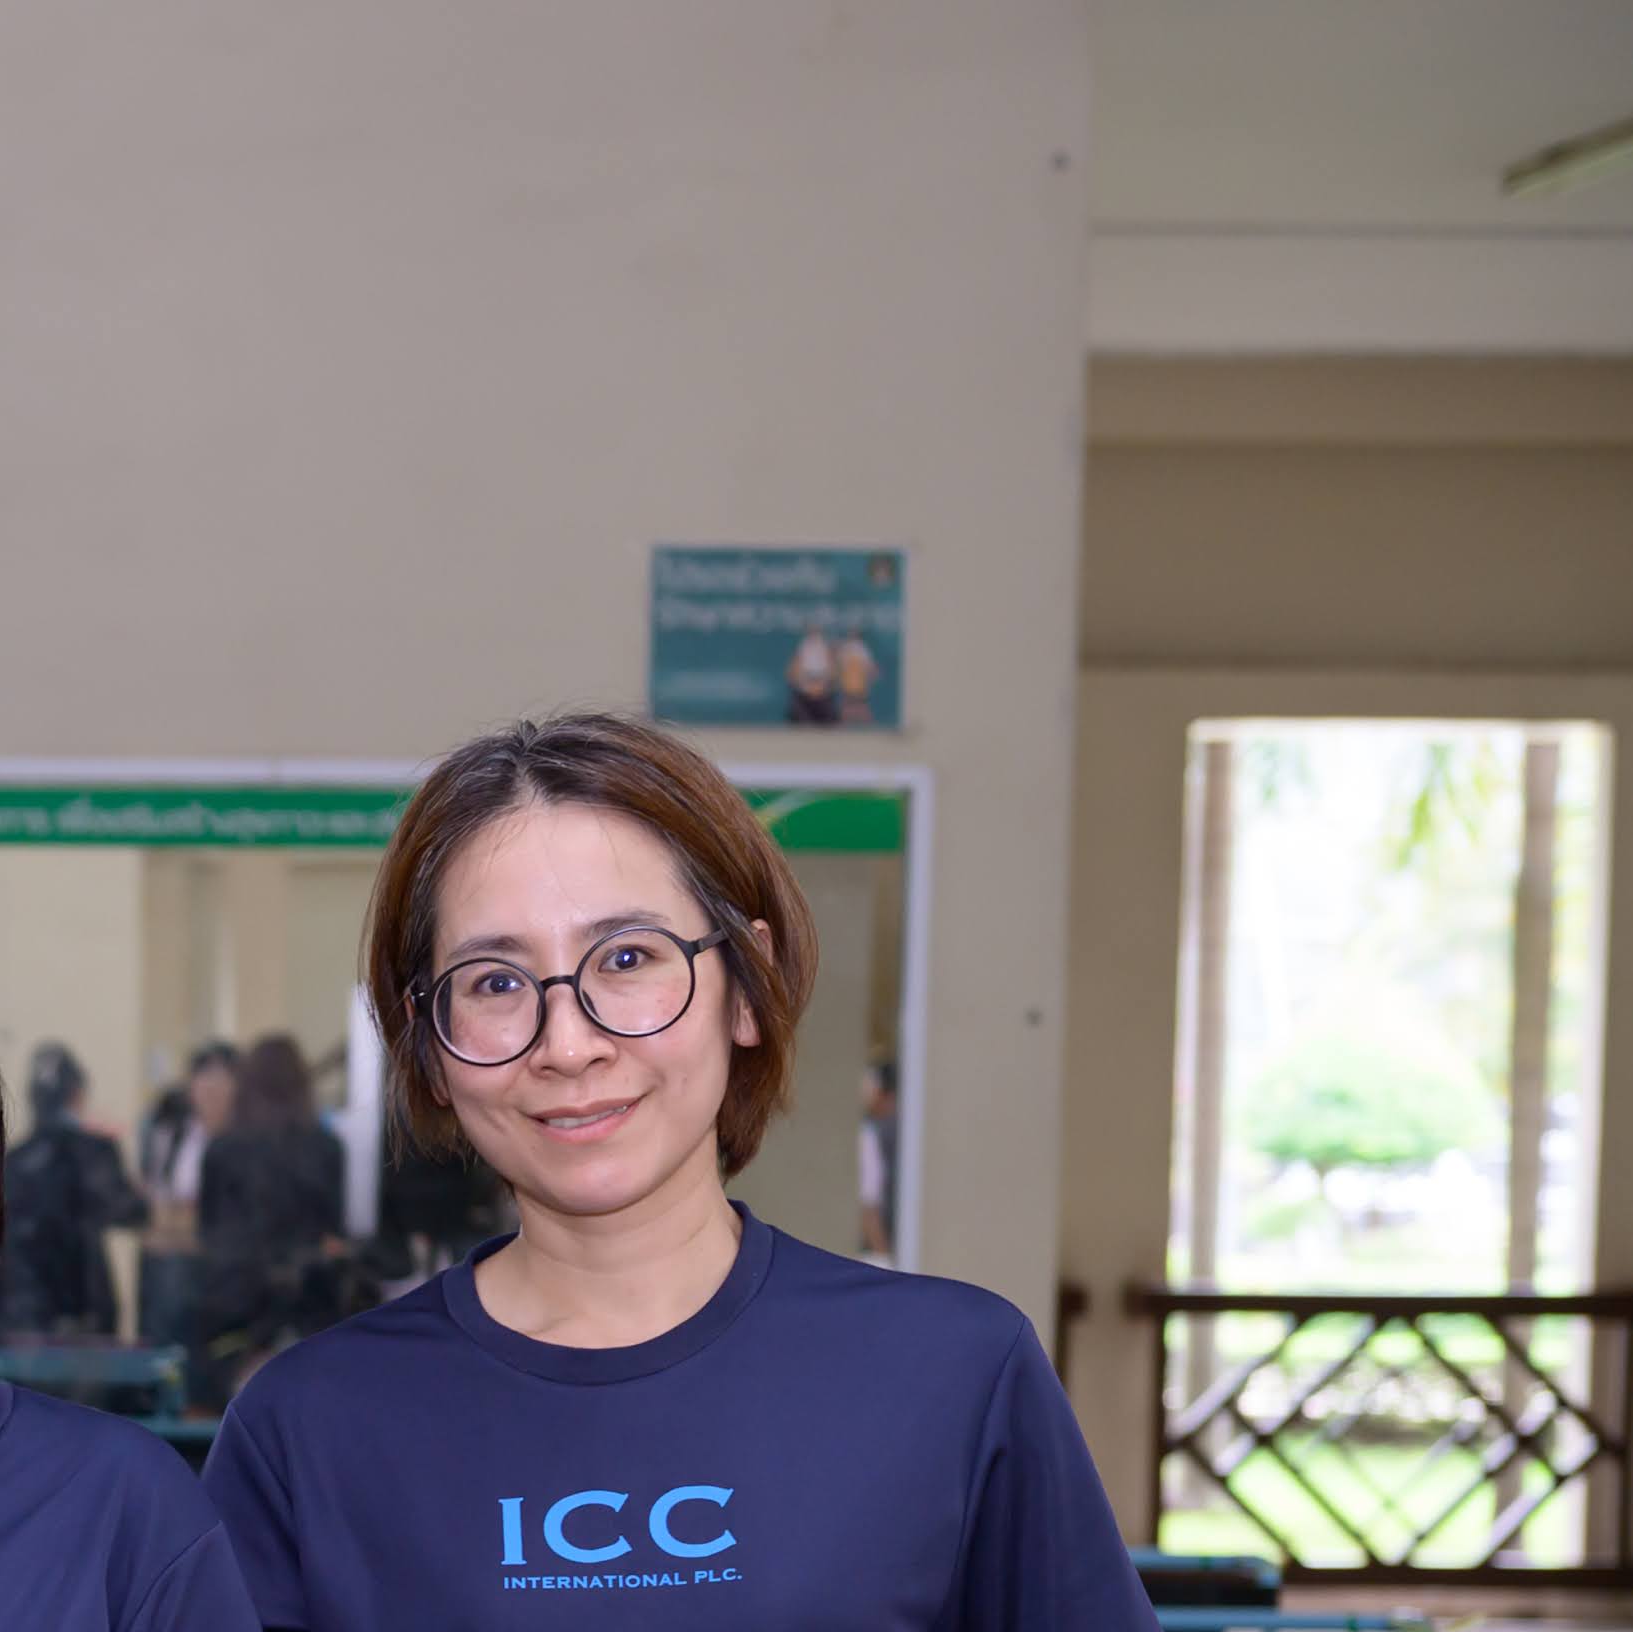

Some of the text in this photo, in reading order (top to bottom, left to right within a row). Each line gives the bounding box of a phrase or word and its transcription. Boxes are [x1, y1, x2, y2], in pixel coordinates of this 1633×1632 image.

[498, 1485, 736, 1565] ICC
[504, 1568, 742, 1589] INTERNATIONAL PLC.
